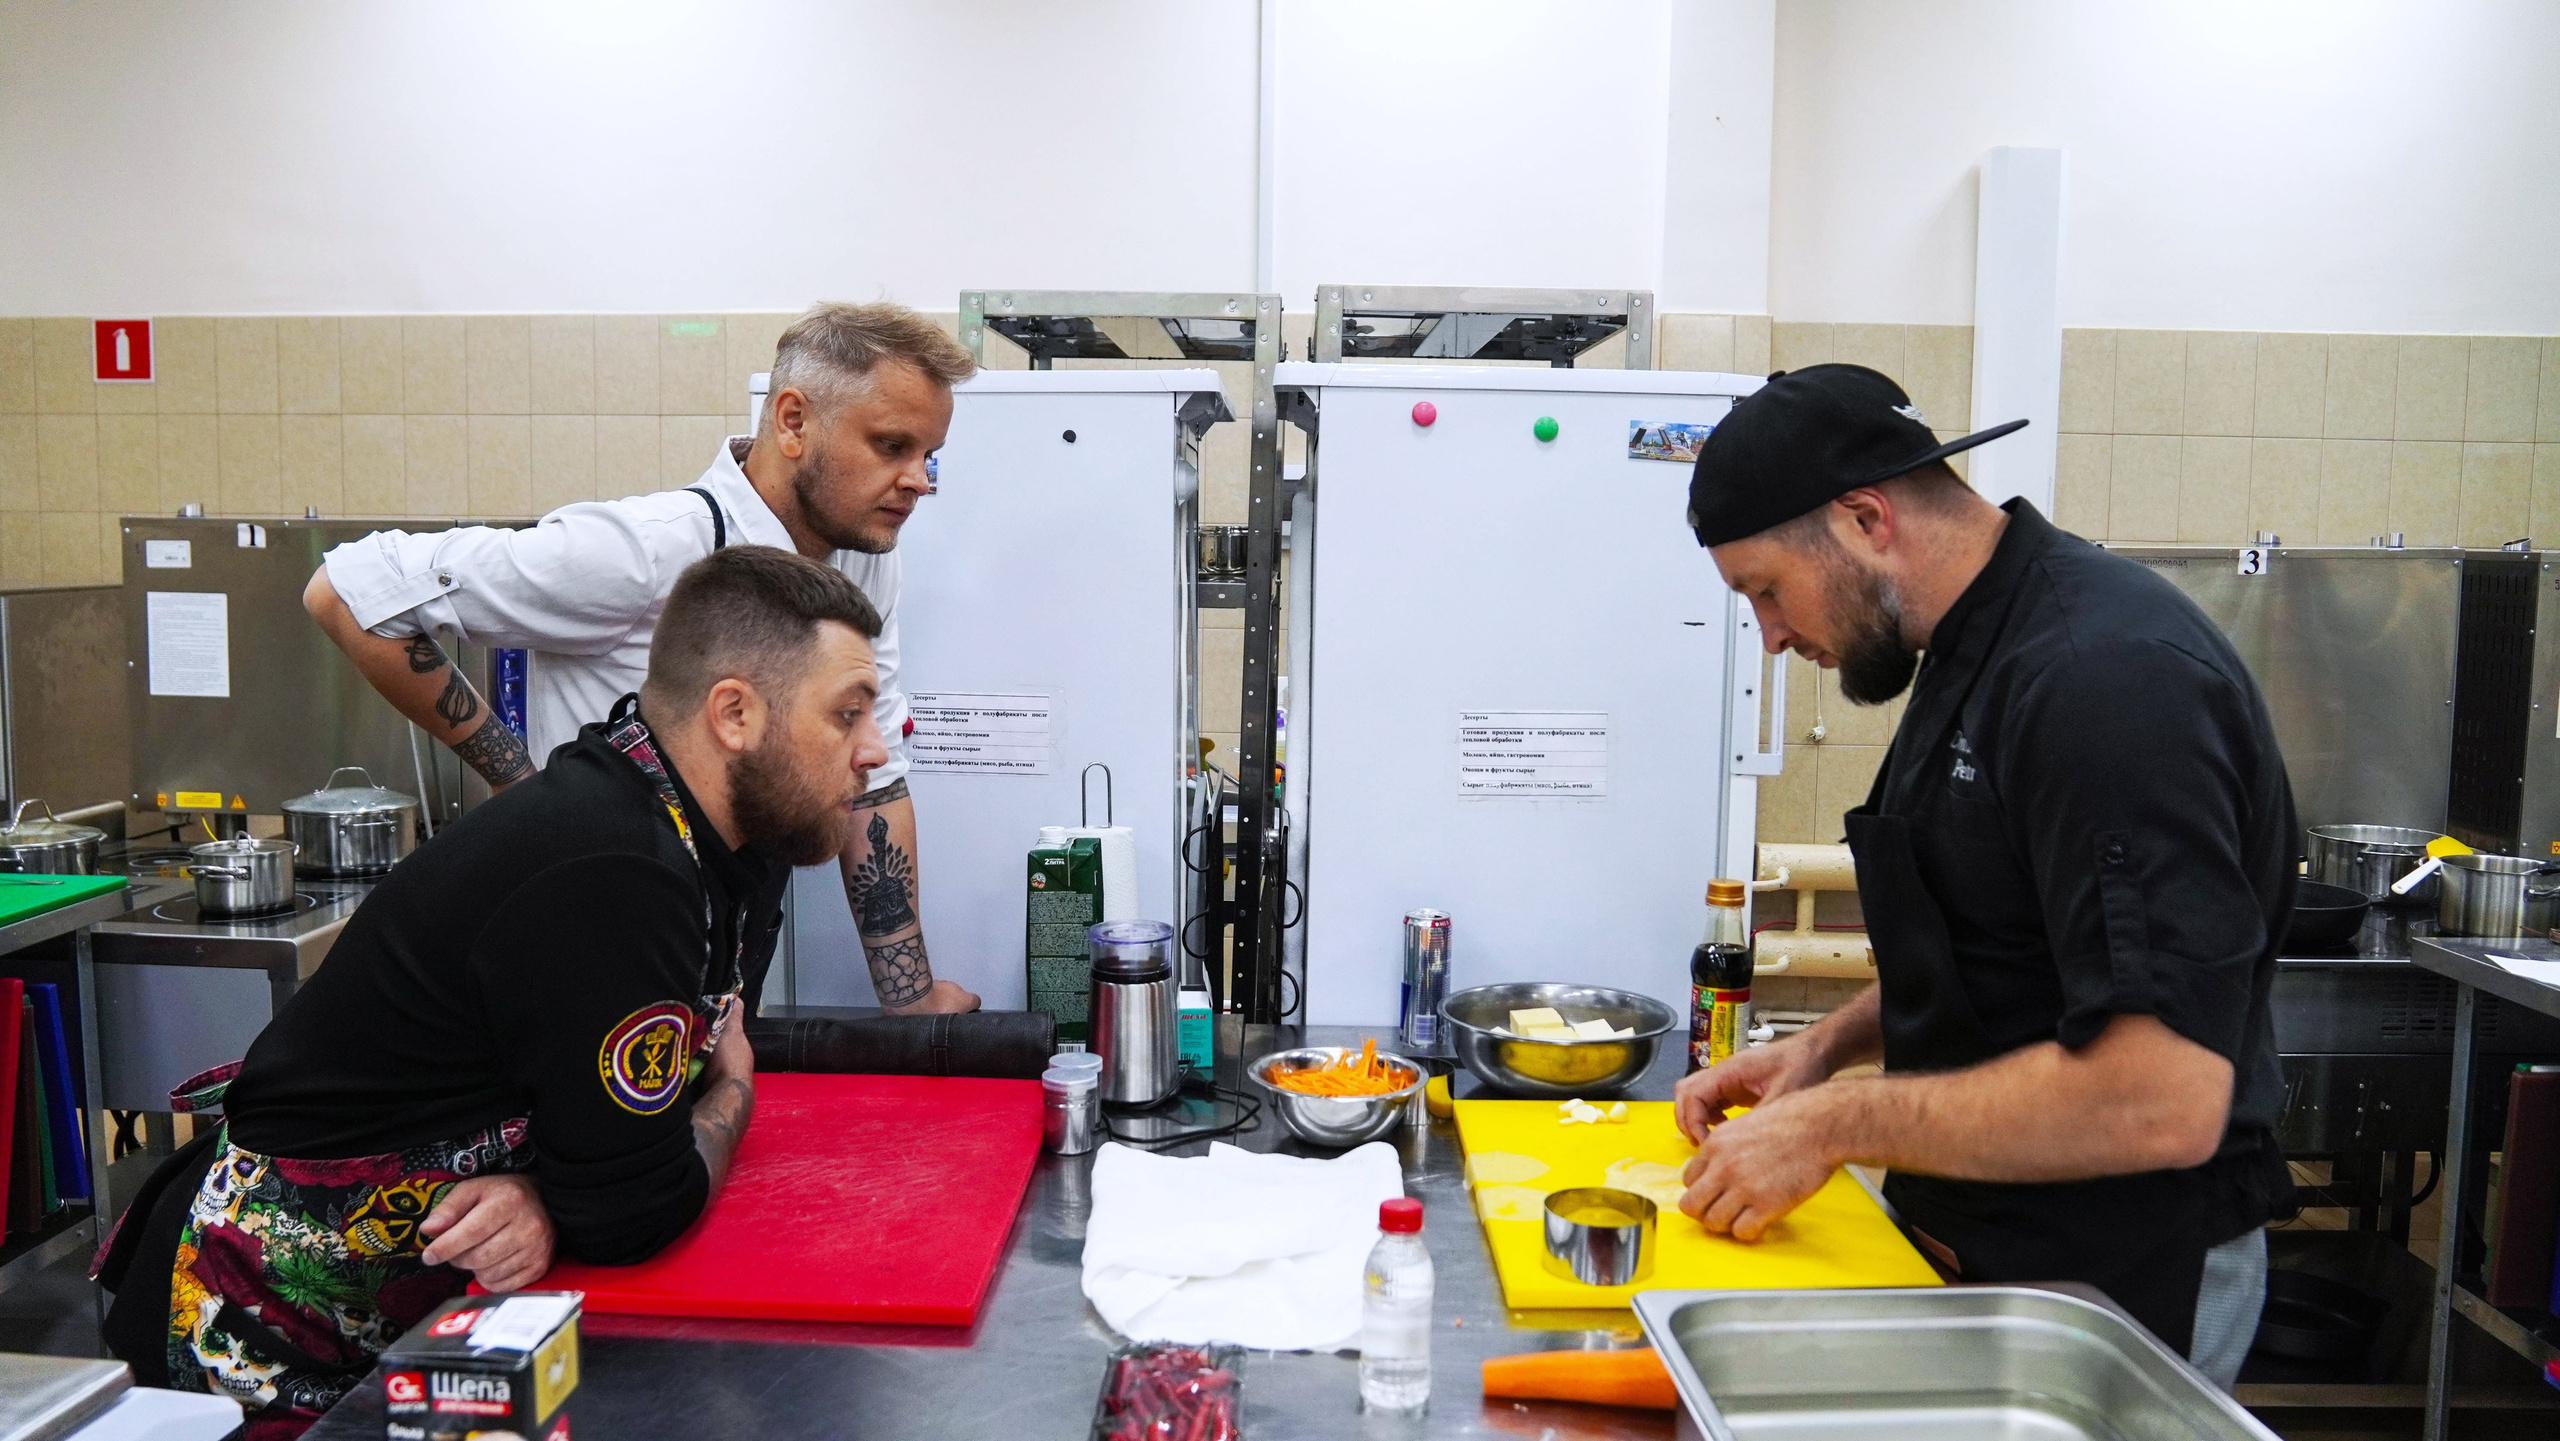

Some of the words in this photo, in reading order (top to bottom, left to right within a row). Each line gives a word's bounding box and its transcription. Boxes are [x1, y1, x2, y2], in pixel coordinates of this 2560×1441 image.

[2243, 550, 2260, 575] 3
[1537, 729, 1585, 737] полуфабрикаты
[938, 744, 961, 752] фрукты
[1490, 766, 1514, 774] фрукты
[1462, 781, 1485, 789] Сырые
[1044, 858, 1050, 866] 2
[431, 1370, 512, 1402] Щепа
